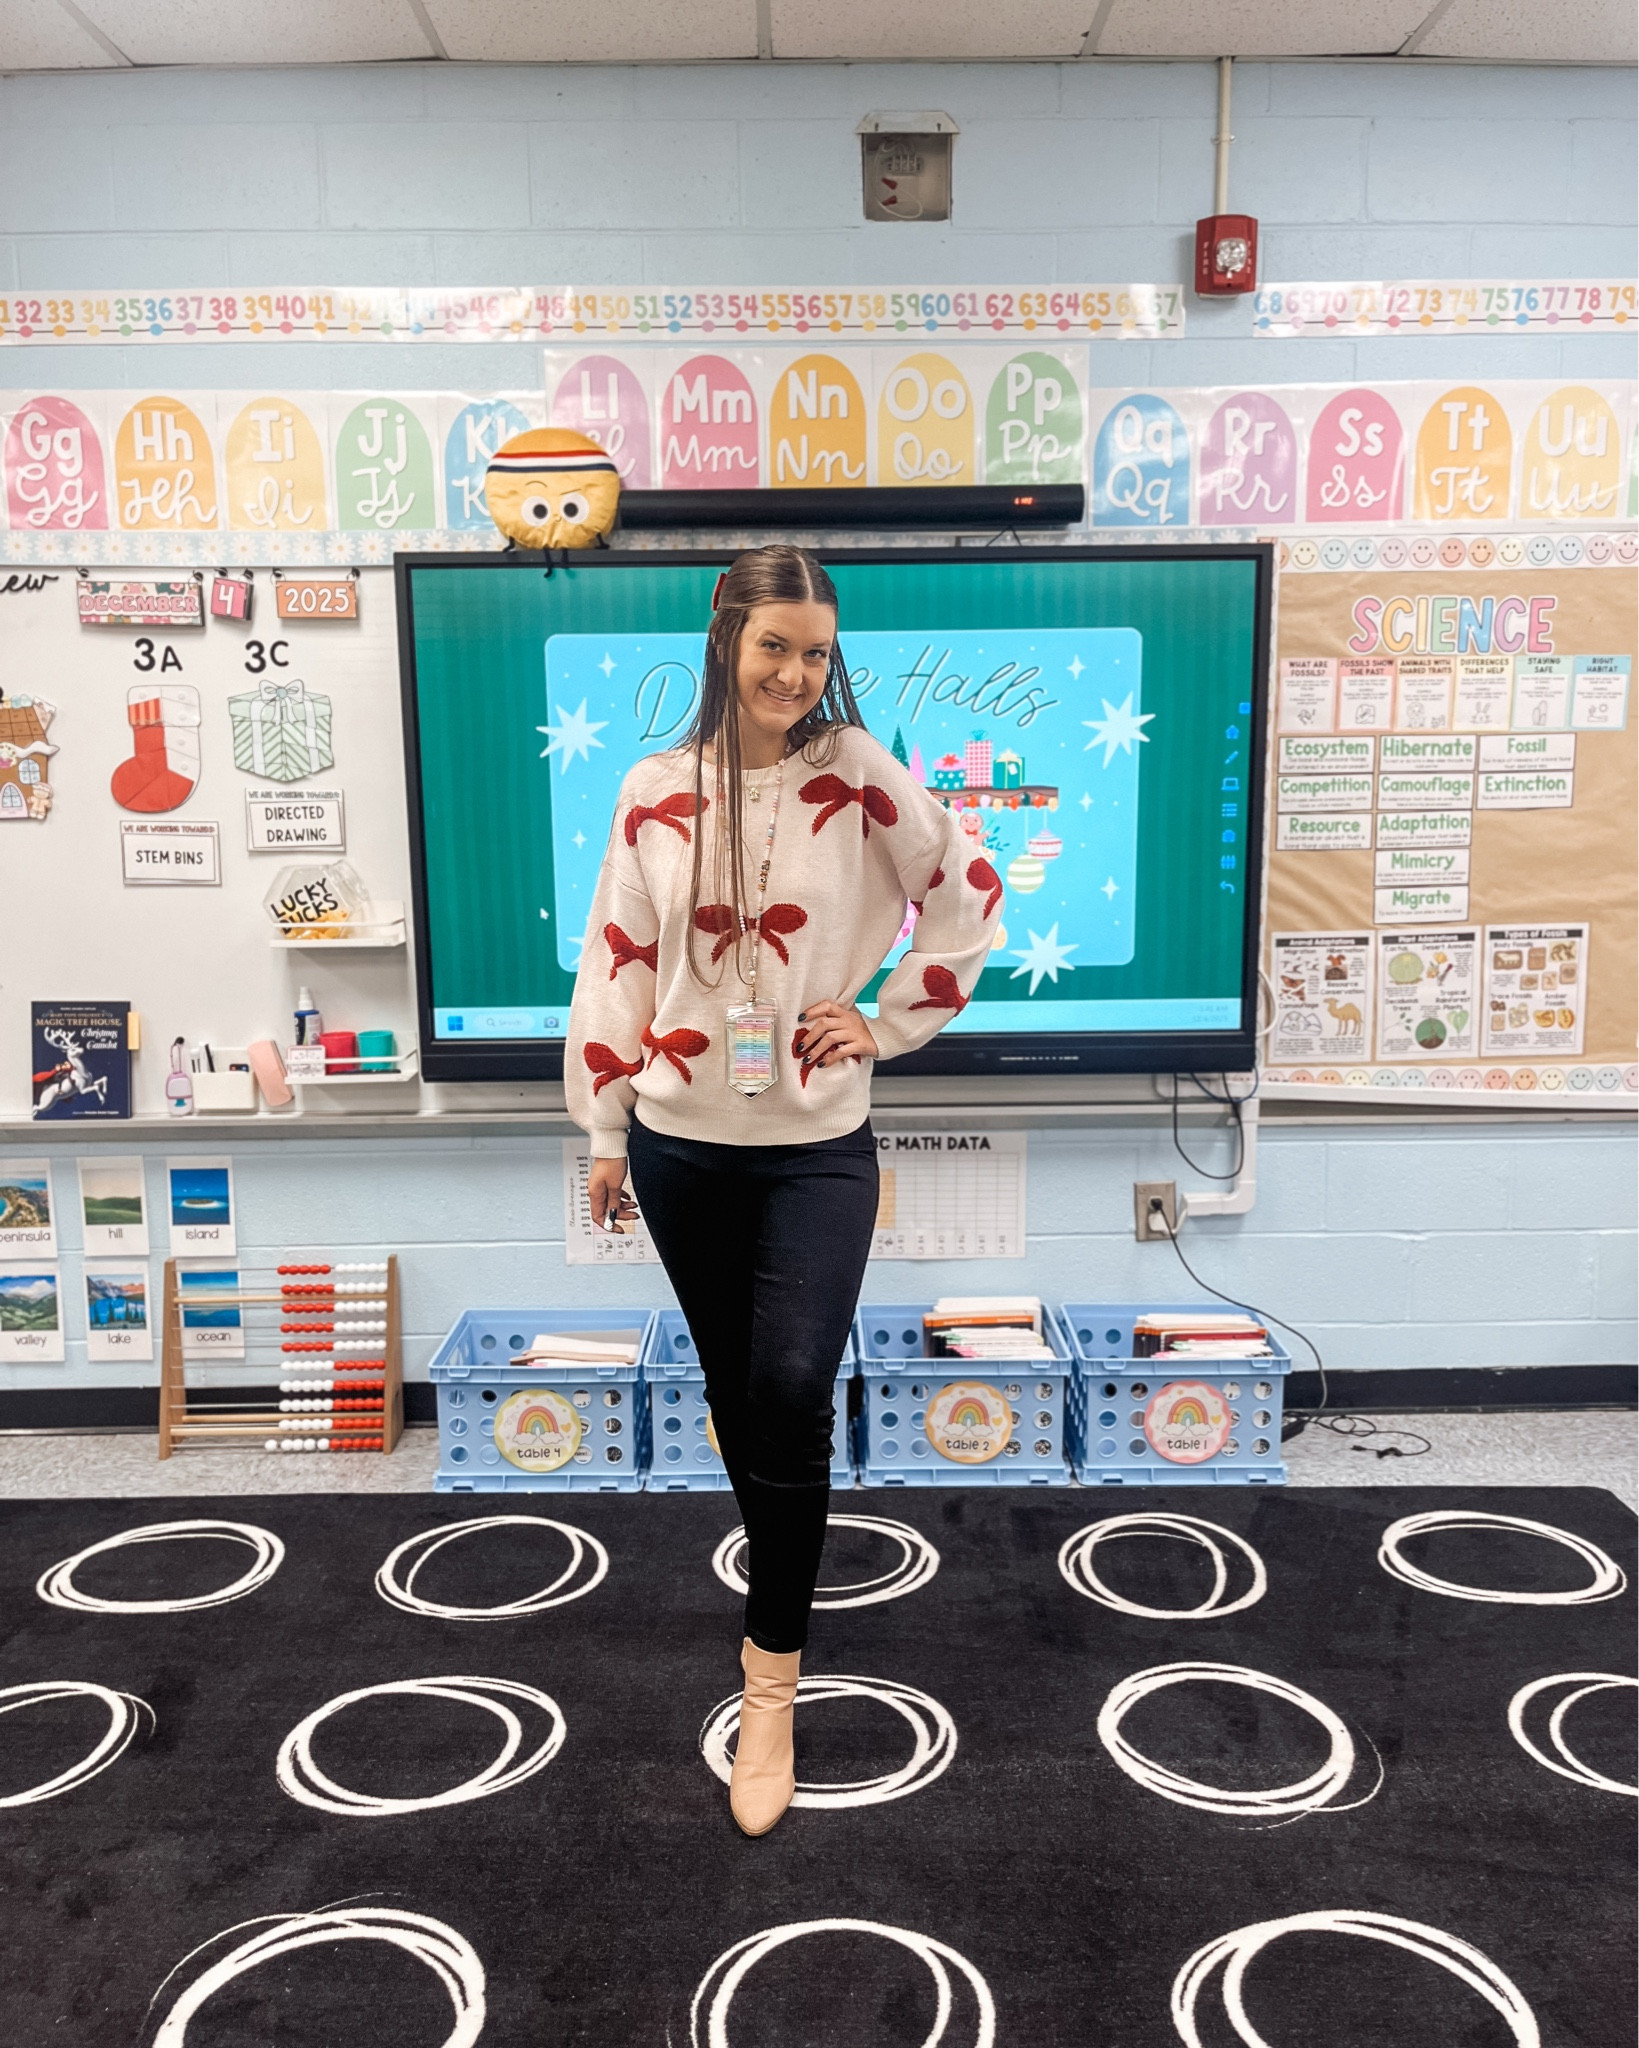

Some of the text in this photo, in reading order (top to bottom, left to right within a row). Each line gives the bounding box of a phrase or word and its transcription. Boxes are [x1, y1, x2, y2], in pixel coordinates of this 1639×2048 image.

[14, 300, 42, 323] 32
[47, 300, 74, 323] 33
[81, 300, 110, 322] 34
[115, 299, 143, 322] 35
[144, 298, 173, 321] 36
[176, 297, 203, 320] 37
[210, 297, 237, 320] 38
[244, 296, 272, 320] 39
[276, 296, 306, 319] 40
[307, 295, 335, 320] 41
[536, 295, 564, 319] 48
[570, 295, 598, 319] 49
[600, 295, 630, 319] 50
[634, 295, 660, 319] 51
[664, 294, 692, 319] 52
[696, 294, 724, 318] 53
[728, 294, 758, 318] 54
[761, 294, 791, 318] 55
[792, 294, 821, 318] 56
[824, 294, 852, 318] 57
[858, 294, 886, 318] 58
[891, 293, 920, 317] 59
[921, 294, 950, 317] 60
[953, 293, 978, 317] 61
[985, 293, 1014, 317] 62
[1019, 293, 1047, 316] 63
[1050, 292, 1080, 317] 64
[1081, 292, 1110, 316] 65
[1254, 286, 1636, 314] 68 69 70 71 72 73 74 75 76 77 78 79
[581, 370, 619, 420] Ll
[673, 374, 752, 424] Mm
[788, 369, 848, 420] Nn
[886, 367, 966, 421] Oo
[1007, 363, 1062, 426] Pp
[133, 411, 194, 462] Hh
[253, 410, 295, 462] Ii
[358, 407, 408, 475] Jj
[1114, 404, 1174, 467] Qq
[1224, 408, 1276, 456] Rr
[1335, 408, 1384, 457] Ss
[1441, 403, 1490, 451] Tt
[1540, 404, 1608, 457] Uu
[22, 411, 82, 477] Gg
[664, 435, 757, 476] Mm
[777, 435, 865, 484] Nn
[893, 432, 963, 480] Oo
[999, 418, 1071, 481] Pp
[353, 468, 415, 528] Jj
[451, 476, 491, 519] K
[1106, 462, 1174, 522] Qq
[1214, 468, 1288, 513] Rr
[1320, 464, 1387, 508] Ss
[1431, 465, 1493, 513] Tt
[79, 594, 199, 614] DECEMBER
[219, 584, 234, 615] 4
[285, 588, 350, 613] 2025
[1348, 596, 1557, 654] SCIENCE
[133, 638, 183, 673] 3A
[245, 640, 289, 673] 3C
[1460, 658, 1510, 666] DIFFERENCES
[896, 644, 1060, 727] Halls
[1285, 739, 1369, 758] Ecosystem
[1383, 738, 1473, 756] Hibernate
[1507, 738, 1547, 753] Fossil
[1280, 777, 1371, 797] Competition
[1381, 776, 1471, 796] Camouflage
[1485, 775, 1567, 792] Extinction
[265, 806, 325, 821] DIRECTED
[1290, 817, 1360, 833] Resource
[1379, 813, 1470, 834] Adaptation
[267, 828, 327, 843] DRAWING
[136, 850, 204, 865] STEM BINS
[1391, 852, 1456, 871] Mimicry
[270, 877, 328, 918] LUCKY
[1392, 890, 1451, 910] Migrate
[35, 1018, 122, 1026] MAGIC TREE HOUSE
[80, 1028, 118, 1039] Christmas
[86, 1041, 118, 1050] Camelot
[896, 1136, 942, 1150] MATH
[947, 1136, 992, 1150] DATA
[108, 1228, 124, 1239] hill
[185, 1228, 219, 1240] island
[14, 1334, 47, 1348] valley
[108, 1333, 132, 1344] lake
[196, 1331, 232, 1342] ocean
[517, 1448, 561, 1458] table 4
[945, 1439, 990, 1451] table 2
[1167, 1439, 1201, 1450] table
